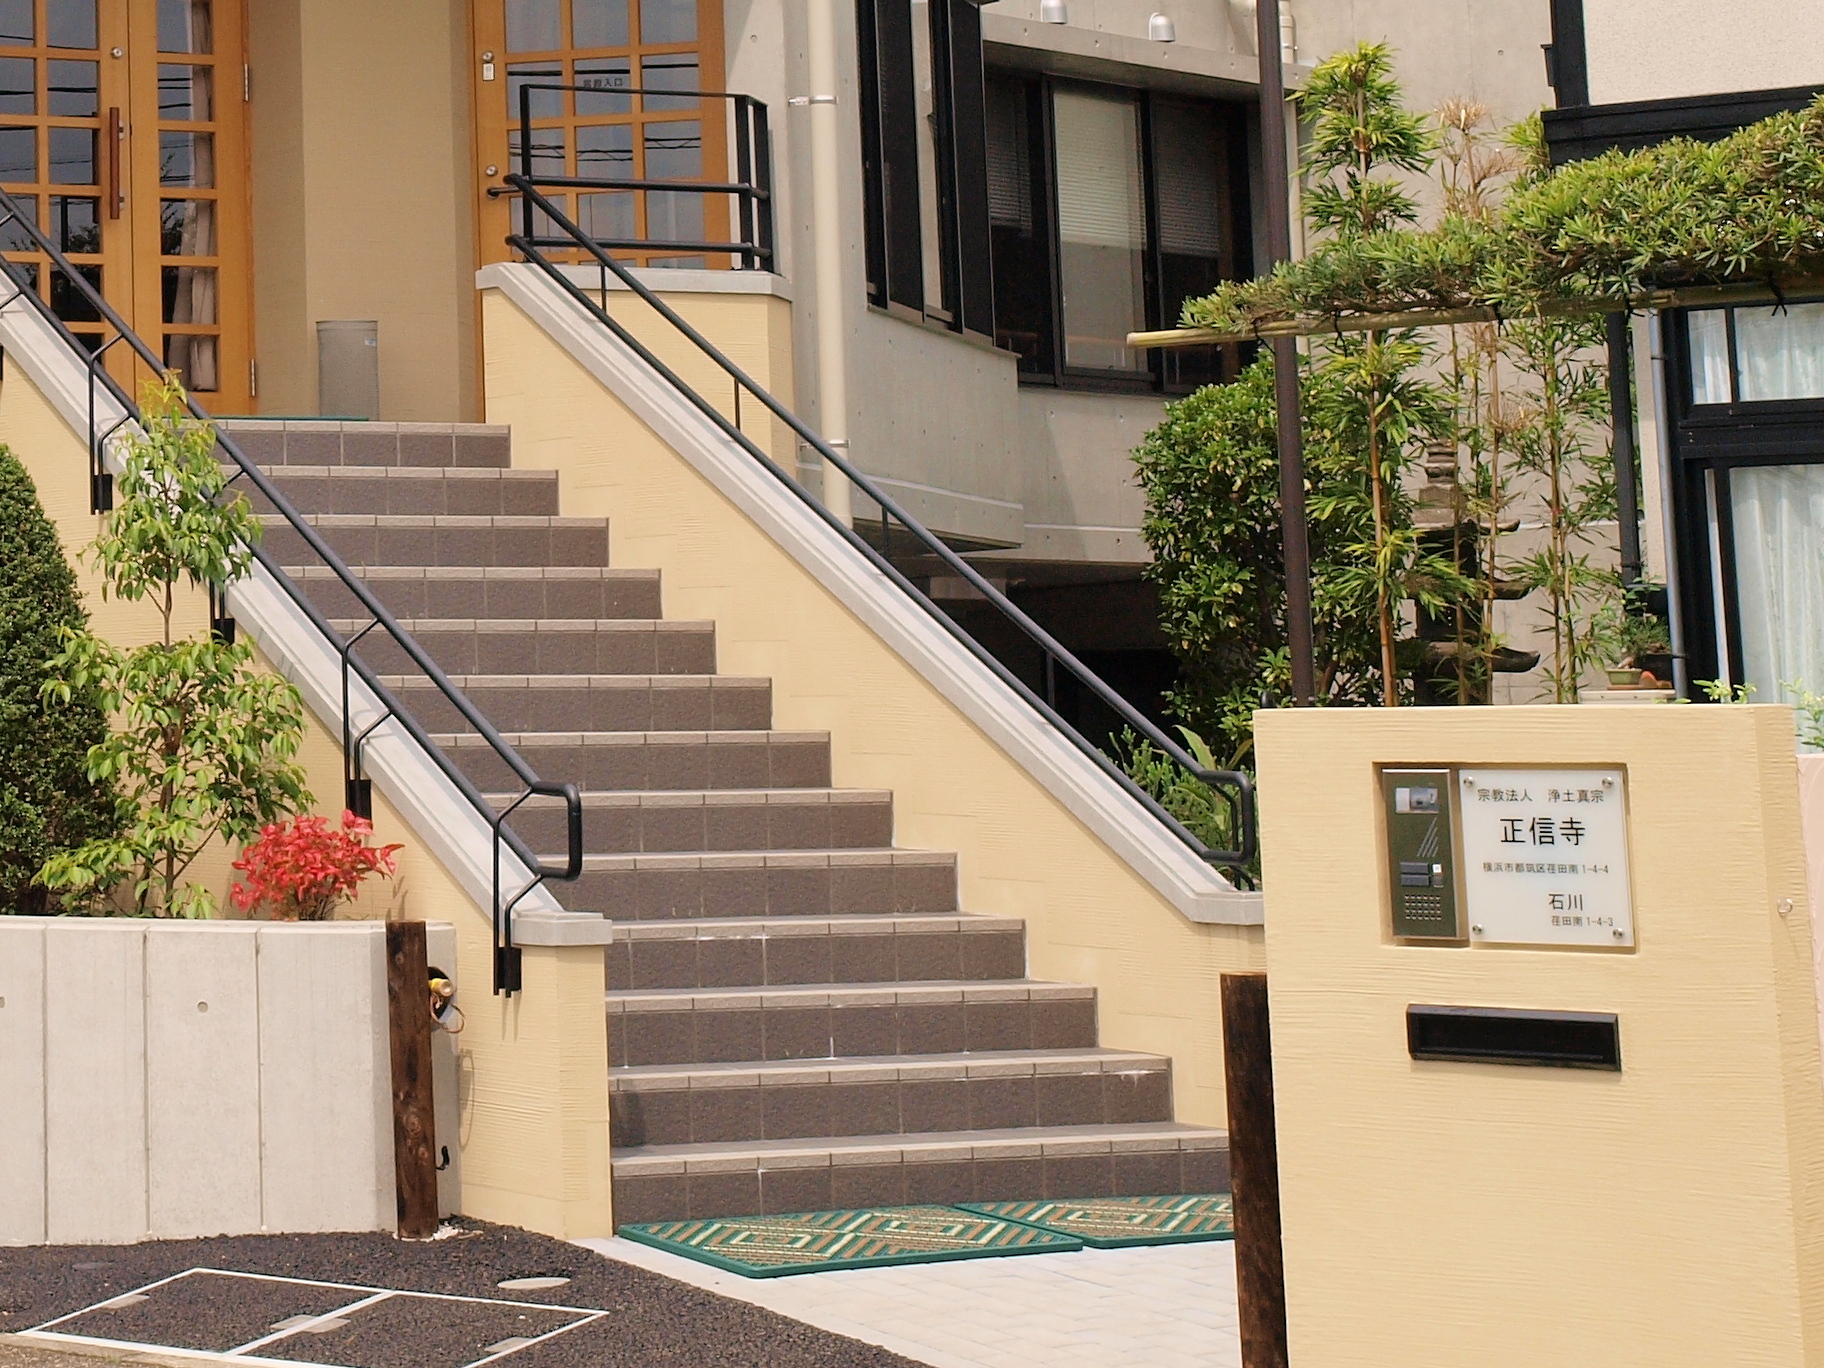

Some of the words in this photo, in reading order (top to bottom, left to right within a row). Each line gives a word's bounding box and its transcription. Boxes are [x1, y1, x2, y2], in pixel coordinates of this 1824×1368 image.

[1477, 788, 1533, 803] 宗教法人
[1547, 788, 1604, 803] 浄土真宗
[1499, 816, 1586, 846] 正信寺
[1548, 893, 1584, 911] 石川
